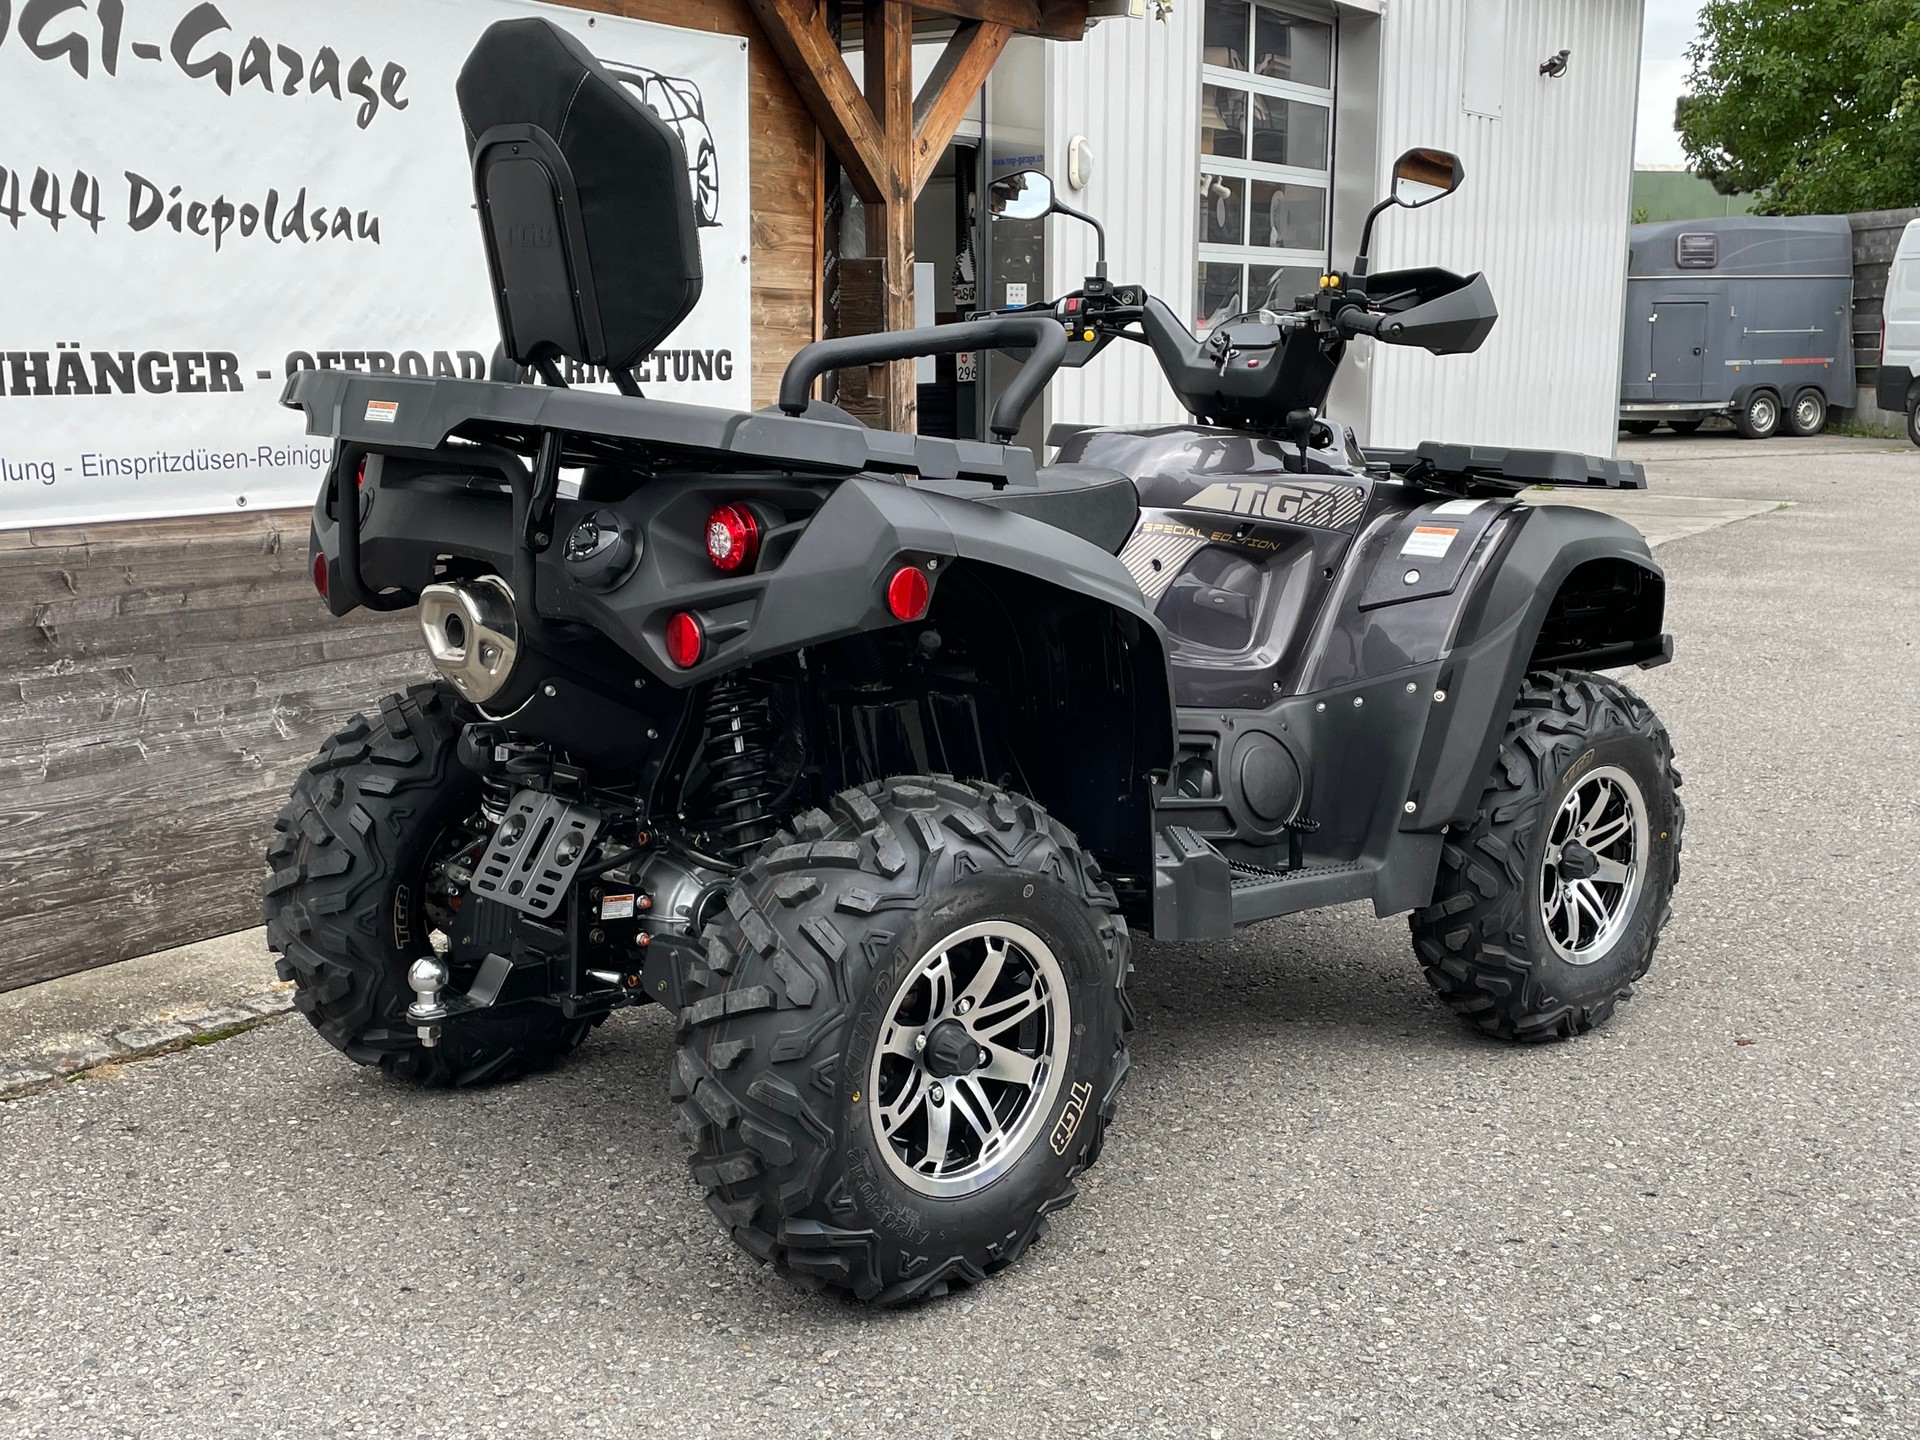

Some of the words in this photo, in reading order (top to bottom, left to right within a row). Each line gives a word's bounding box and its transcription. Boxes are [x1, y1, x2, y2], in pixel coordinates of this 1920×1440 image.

[0, 0, 406, 130] GI-Garage
[124, 170, 380, 252] Diepoldsau
[0, 341, 244, 396] HÄNGER
[1142, 523, 1205, 539] SPECIAL
[1210, 531, 1281, 551] EDTION
[394, 884, 411, 949] TGB
[844, 944, 910, 1096] KENDA
[1049, 1081, 1093, 1156] TGB
